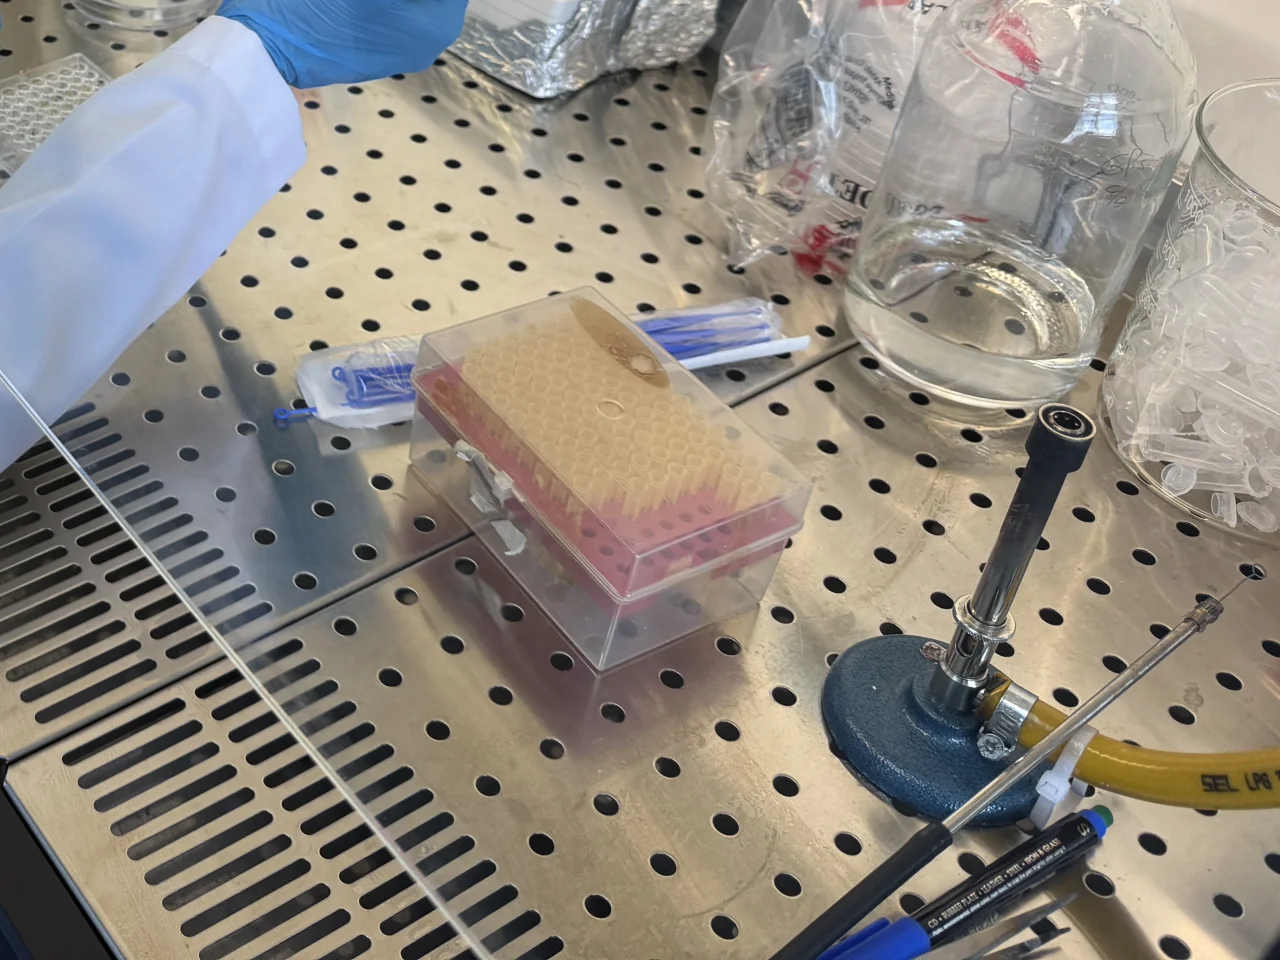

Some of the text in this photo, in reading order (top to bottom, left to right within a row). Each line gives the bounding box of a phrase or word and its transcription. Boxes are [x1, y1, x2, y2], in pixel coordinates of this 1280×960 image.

[1200, 773, 1240, 793] SEL
[927, 918, 939, 929] CD
[940, 901, 964, 920] RUBBER
[961, 891, 980, 907] PLATE
[980, 875, 1006, 894] LEATHER
[1005, 863, 1024, 878] STEEL
[1023, 851, 1040, 866] IRON
